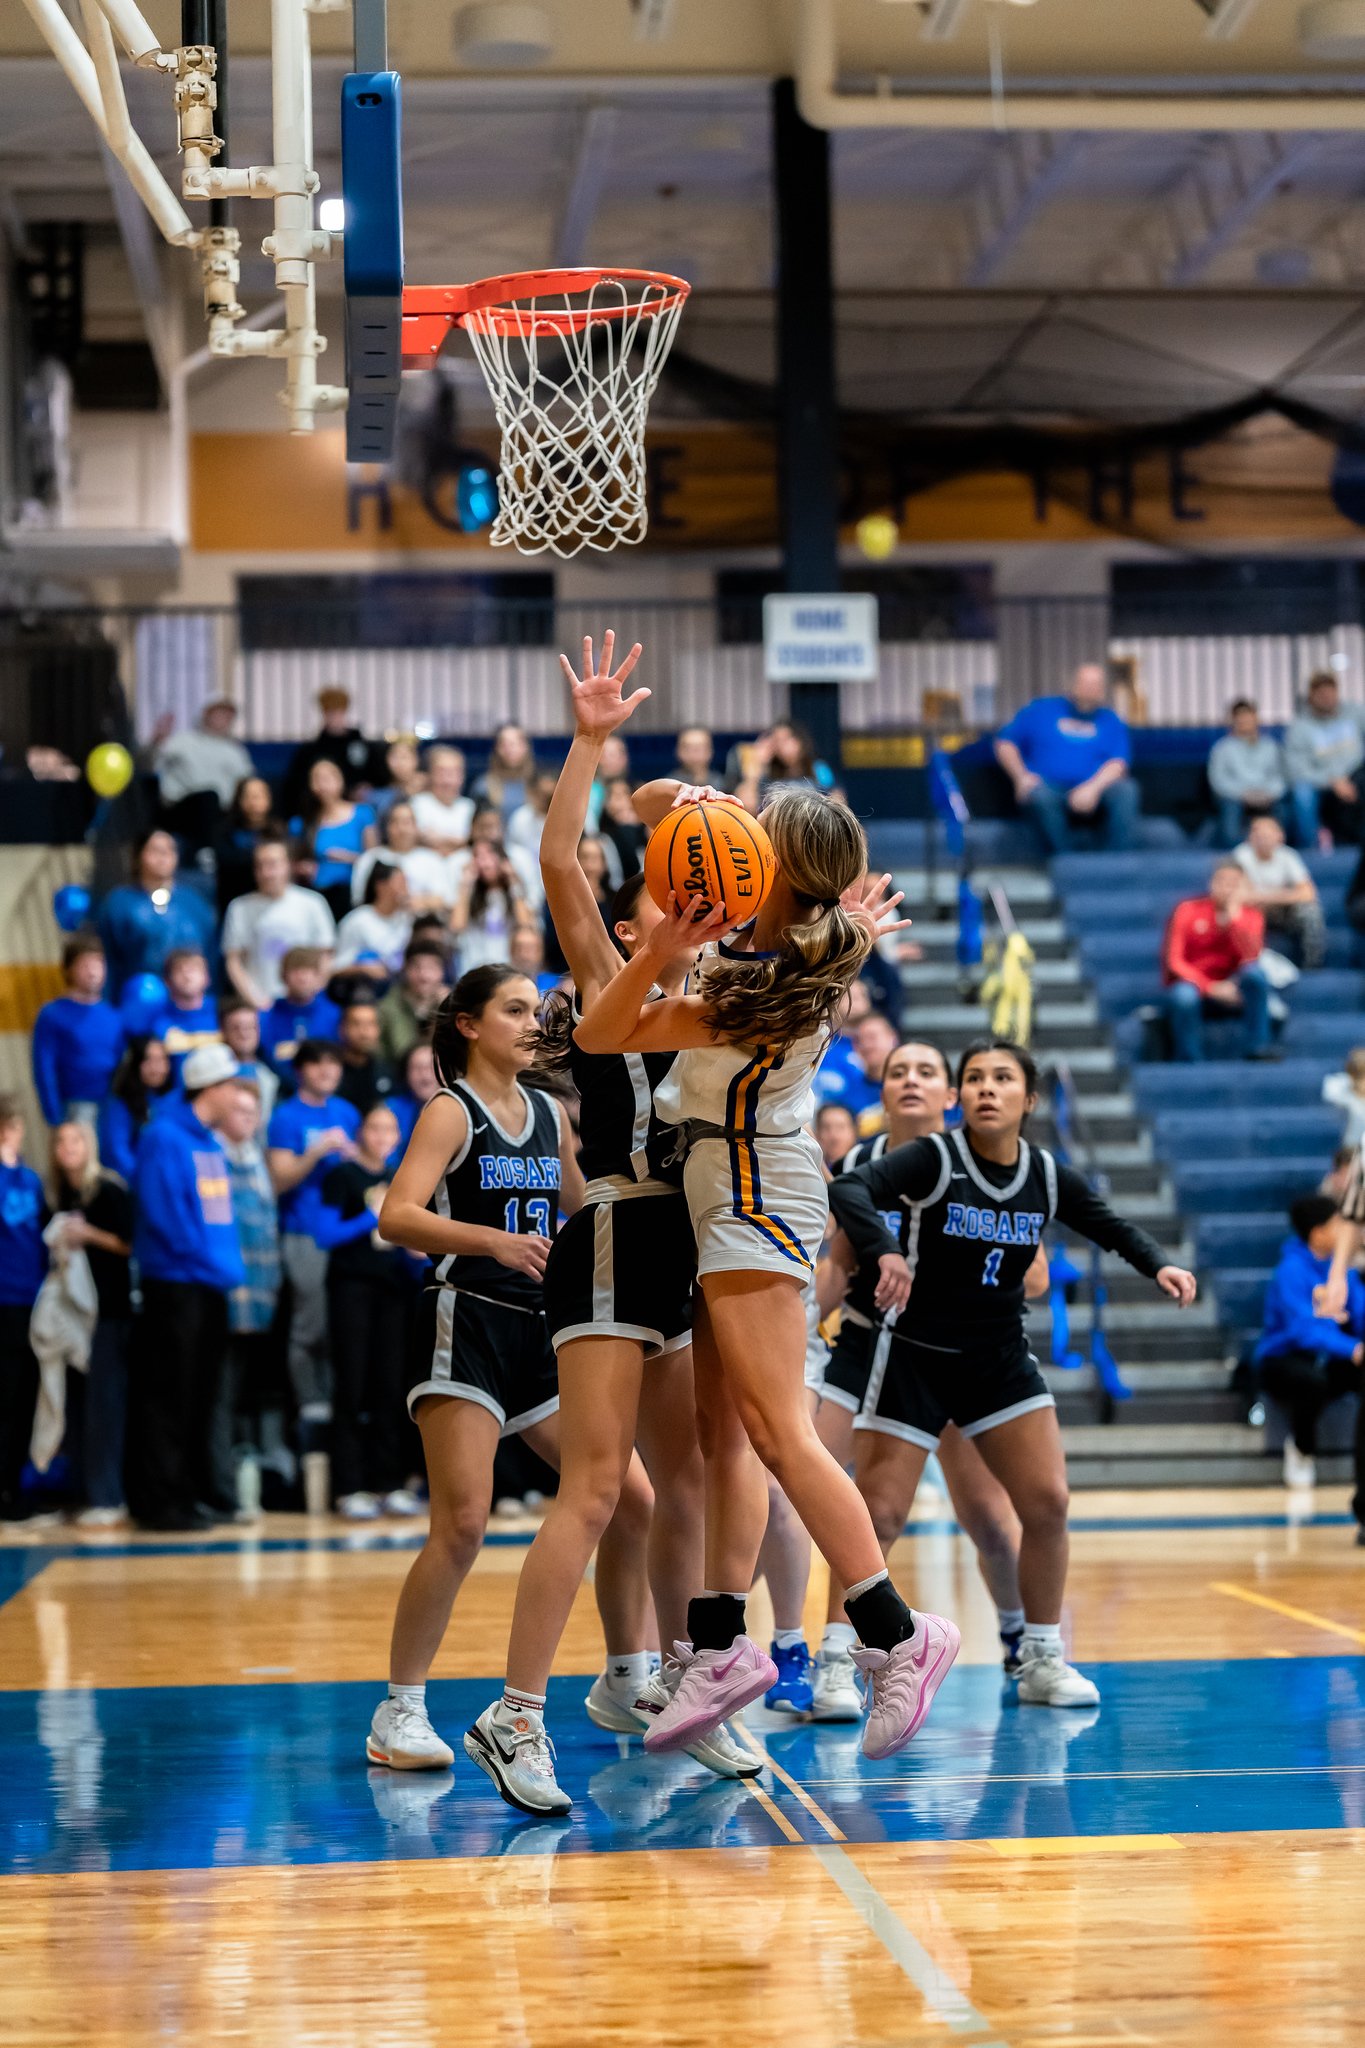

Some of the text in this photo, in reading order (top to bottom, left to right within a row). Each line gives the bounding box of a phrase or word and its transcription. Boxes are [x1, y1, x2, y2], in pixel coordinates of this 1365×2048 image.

[503, 1196, 551, 1239] 13
[943, 1202, 1045, 1245] ROSARY
[981, 1248, 1005, 1287] 1
